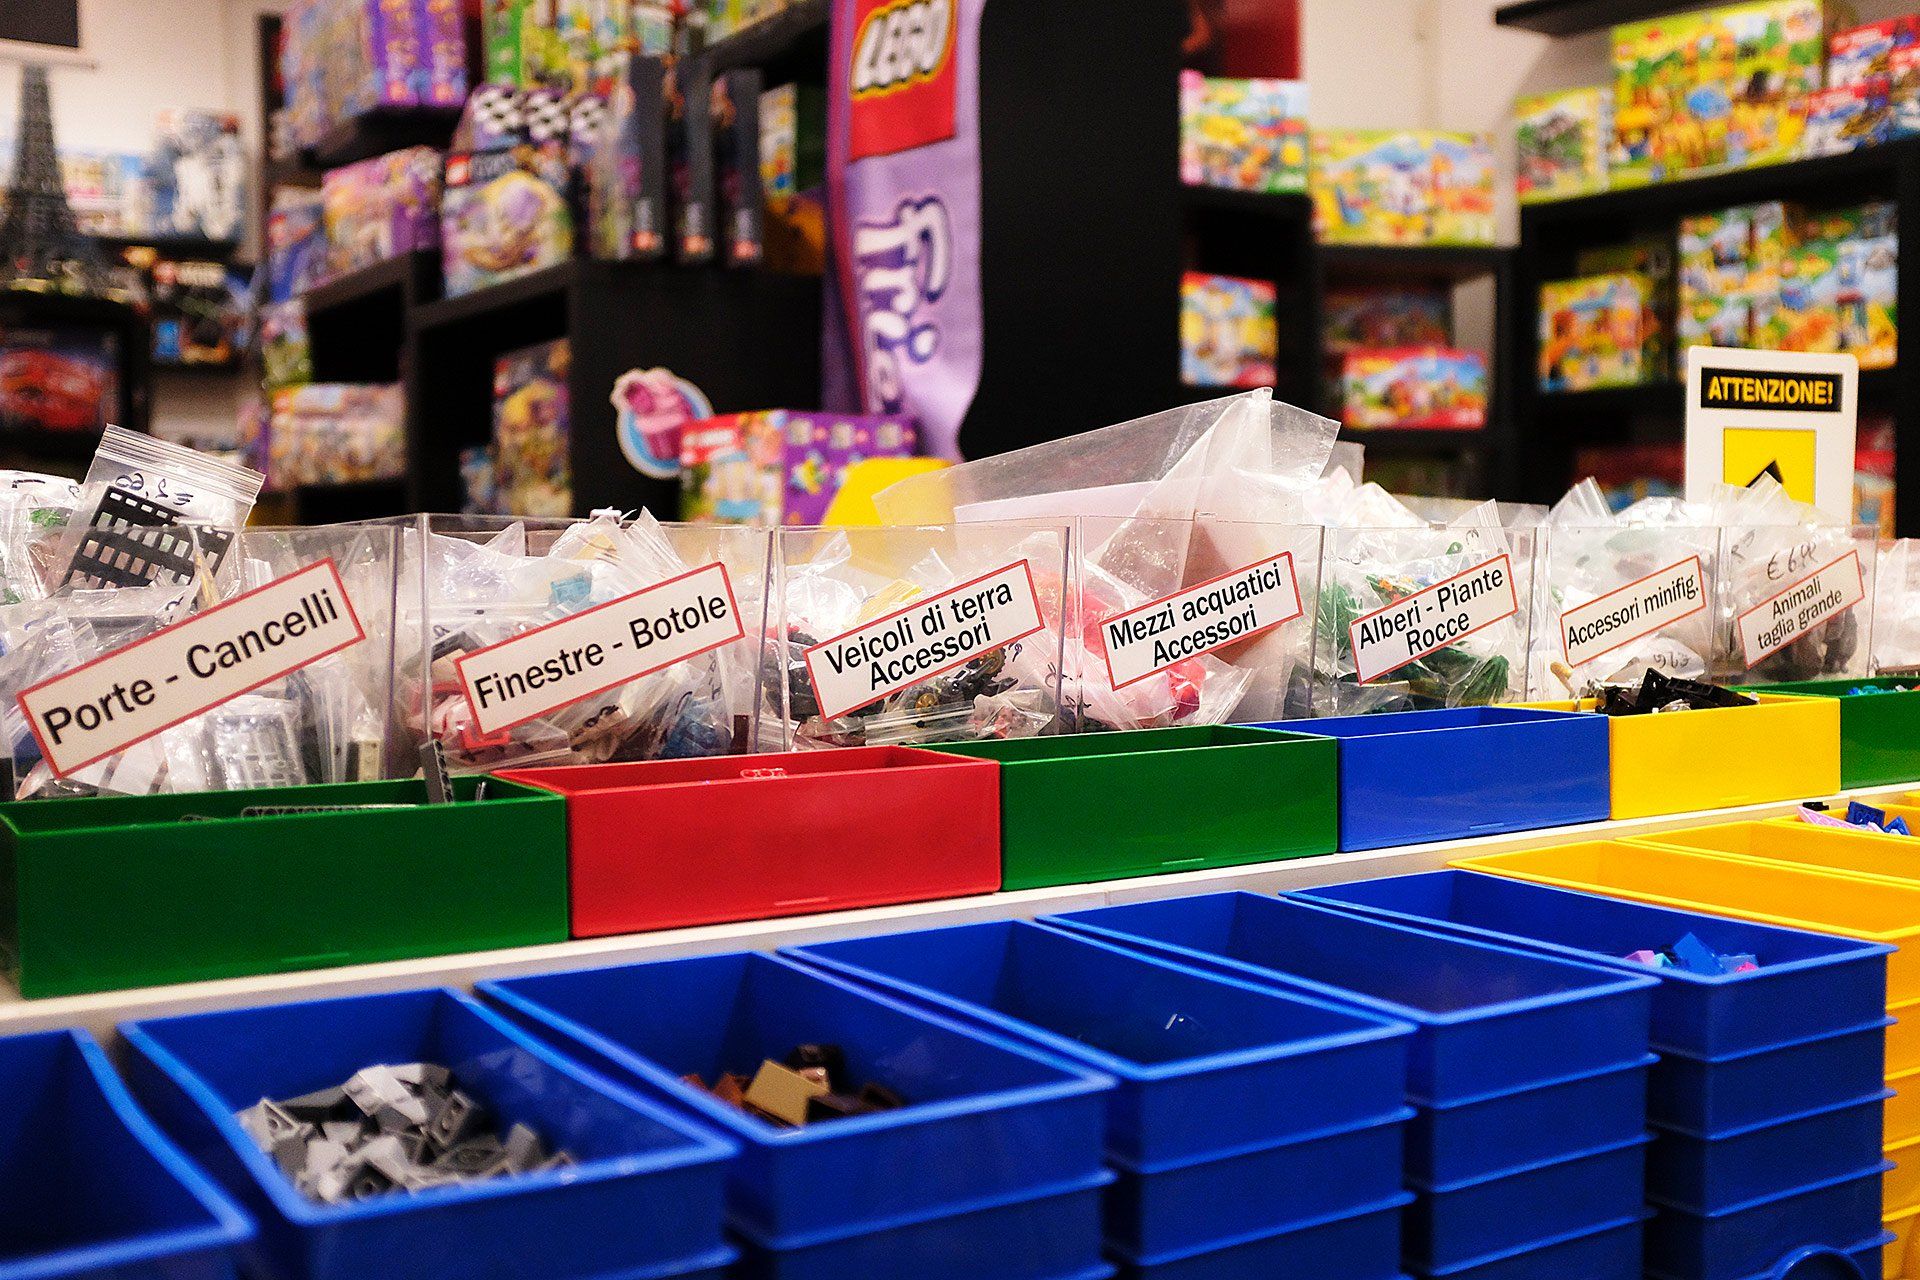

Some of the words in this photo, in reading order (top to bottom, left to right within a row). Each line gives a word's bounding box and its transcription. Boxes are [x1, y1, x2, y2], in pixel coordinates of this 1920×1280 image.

[853, 0, 951, 91] LEGO
[1708, 376, 1834, 406] ATTENZIONE!
[825, 617, 913, 674] Veicoli
[921, 604, 946, 636] di
[951, 583, 1013, 623] terra
[1109, 603, 1176, 650] Mezzi
[1182, 563, 1281, 622] acquatici
[1153, 603, 1258, 667] Accessori
[1360, 600, 1421, 650] Alberi
[1437, 569, 1503, 612] Piante
[1406, 612, 1470, 656] Rocce
[1568, 597, 1640, 650] Accessori
[1644, 574, 1699, 614] minifig.
[1758, 616, 1795, 649] taglia
[1798, 589, 1842, 631] grande
[1773, 575, 1821, 620] Animali
[42, 679, 155, 745] Porte
[186, 588, 338, 678] Cancelli
[474, 642, 604, 709] Finestre
[629, 595, 727, 650] Botole
[871, 616, 991, 691] Accessori
